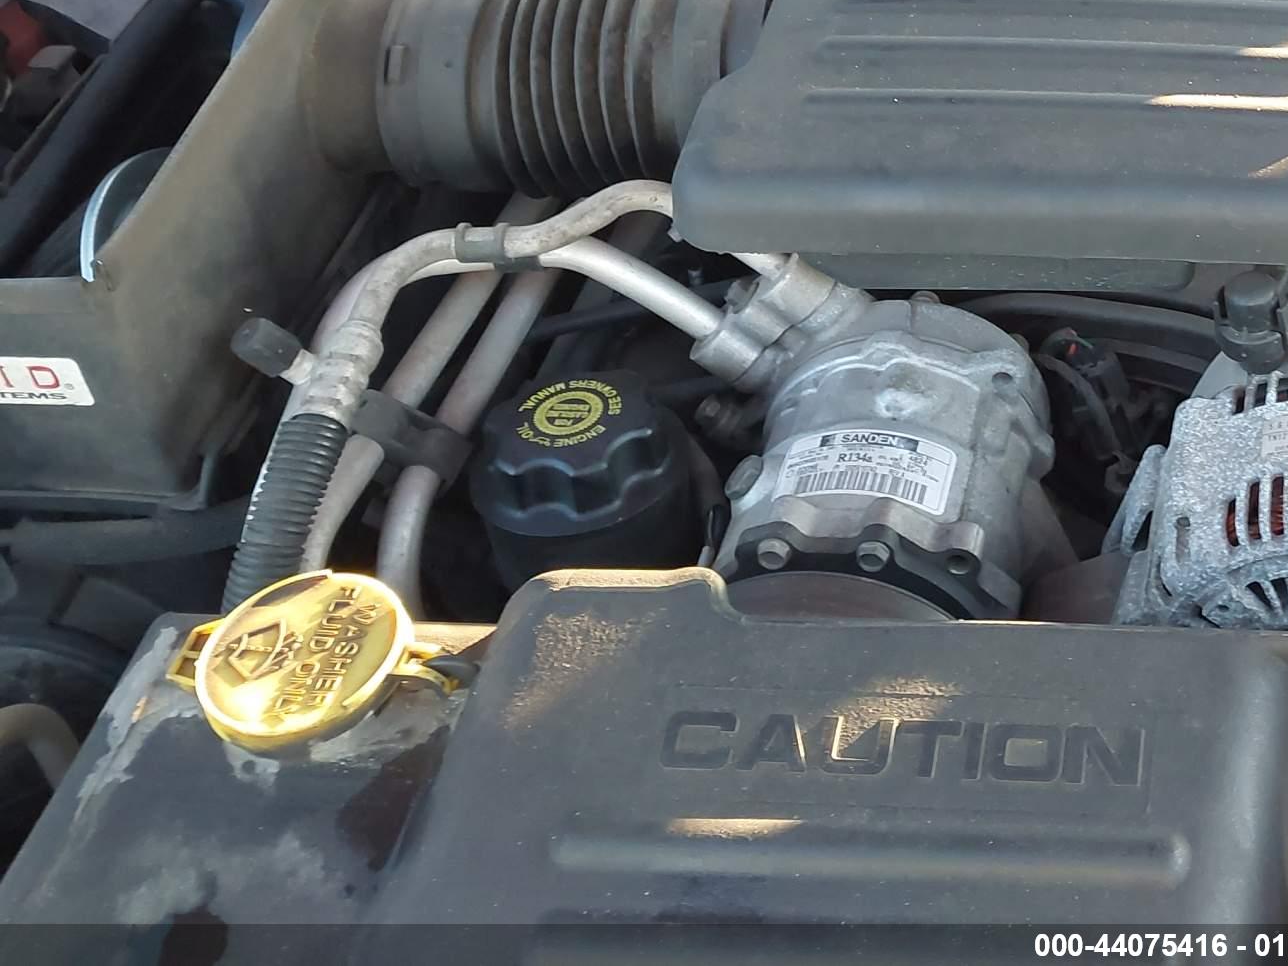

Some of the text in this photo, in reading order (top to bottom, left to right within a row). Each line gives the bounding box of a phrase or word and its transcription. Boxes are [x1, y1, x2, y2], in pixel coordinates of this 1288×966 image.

[518, 382, 567, 412] MANUAL
[516, 421, 607, 447] ENGINE OIL
[841, 433, 899, 446] SANDEN
[837, 452, 874, 464] R134a
[263, 585, 363, 722] FLUID ONLY
[308, 603, 382, 707] WASHER
[657, 709, 1147, 788] CAUTION
